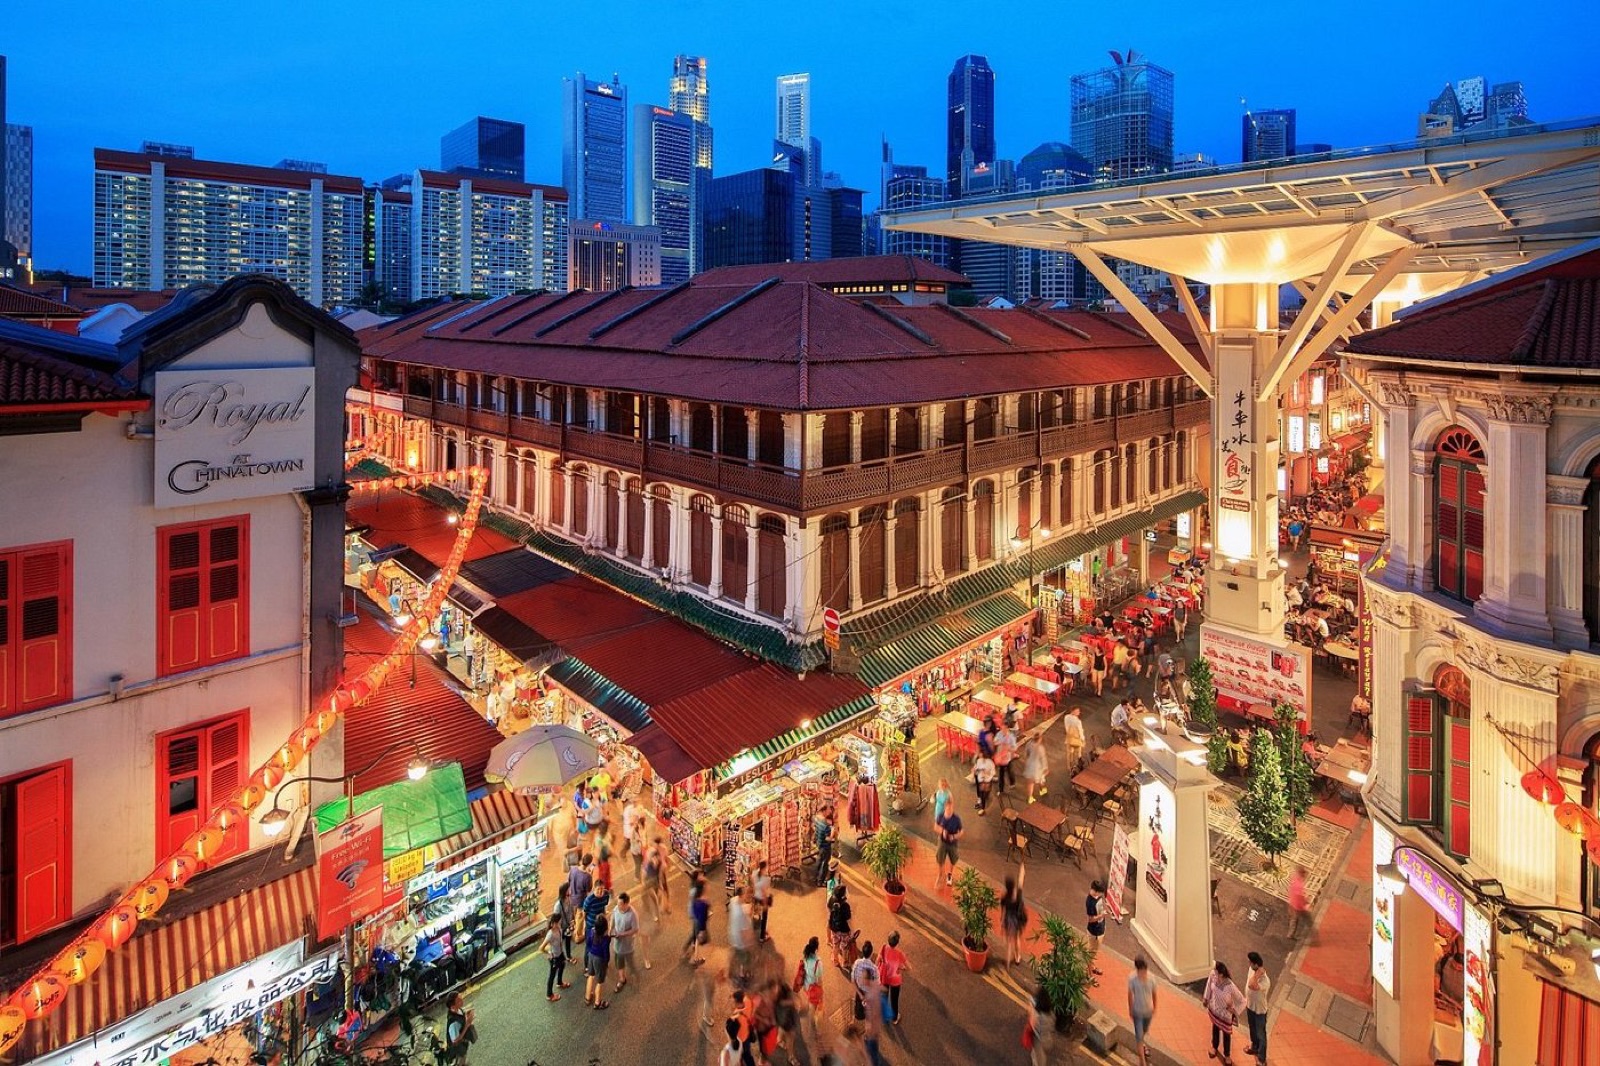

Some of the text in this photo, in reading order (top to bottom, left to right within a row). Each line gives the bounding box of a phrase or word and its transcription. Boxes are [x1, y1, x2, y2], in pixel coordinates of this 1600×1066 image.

[159, 380, 312, 447] Royal
[167, 458, 305, 495] CHINATOWN
[741, 761, 773, 784] LESLIE
